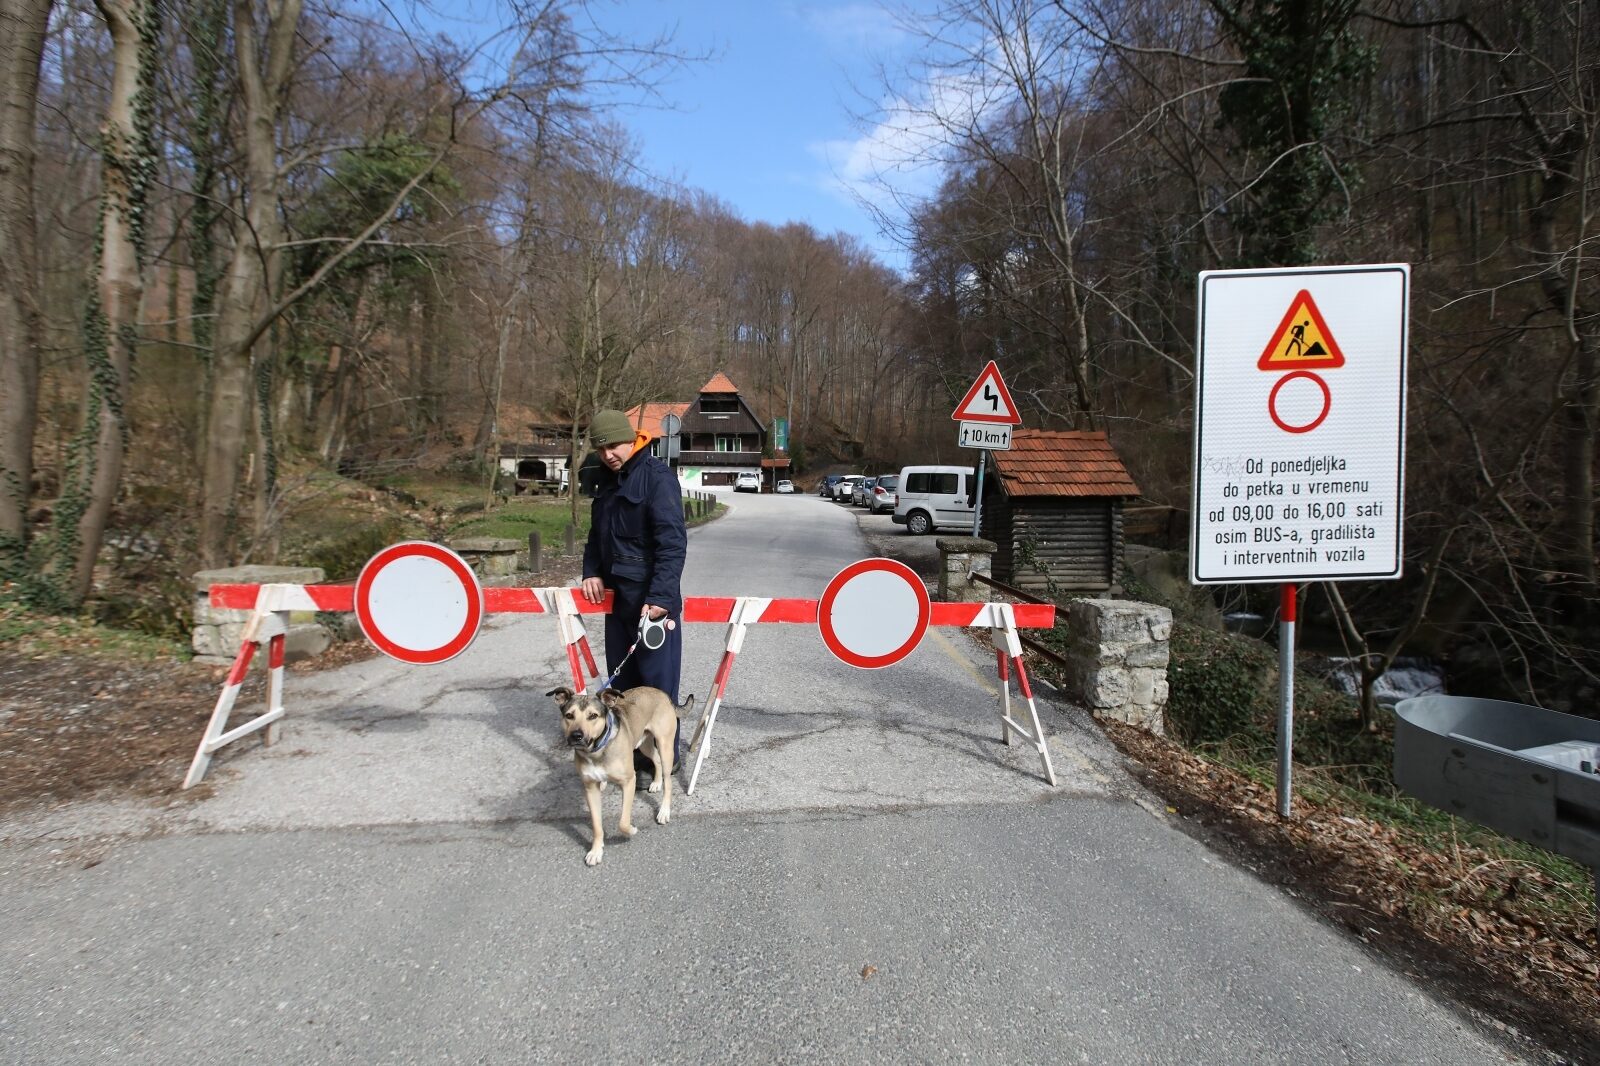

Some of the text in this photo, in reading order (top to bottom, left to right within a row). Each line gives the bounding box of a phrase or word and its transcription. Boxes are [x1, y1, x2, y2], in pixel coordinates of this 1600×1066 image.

[972, 429, 1000, 443] 10 km
[1246, 458, 1263, 474] Od
[1271, 455, 1346, 477] ponedjeljka
[1223, 480, 1369, 501] do petka u vremenu
[1209, 501, 1383, 523] od 09,00 do 16,00 sati
[1215, 529, 1247, 544] osim
[1254, 526, 1303, 544] BUS-a,
[1223, 545, 1365, 566] i interventnih vozila
